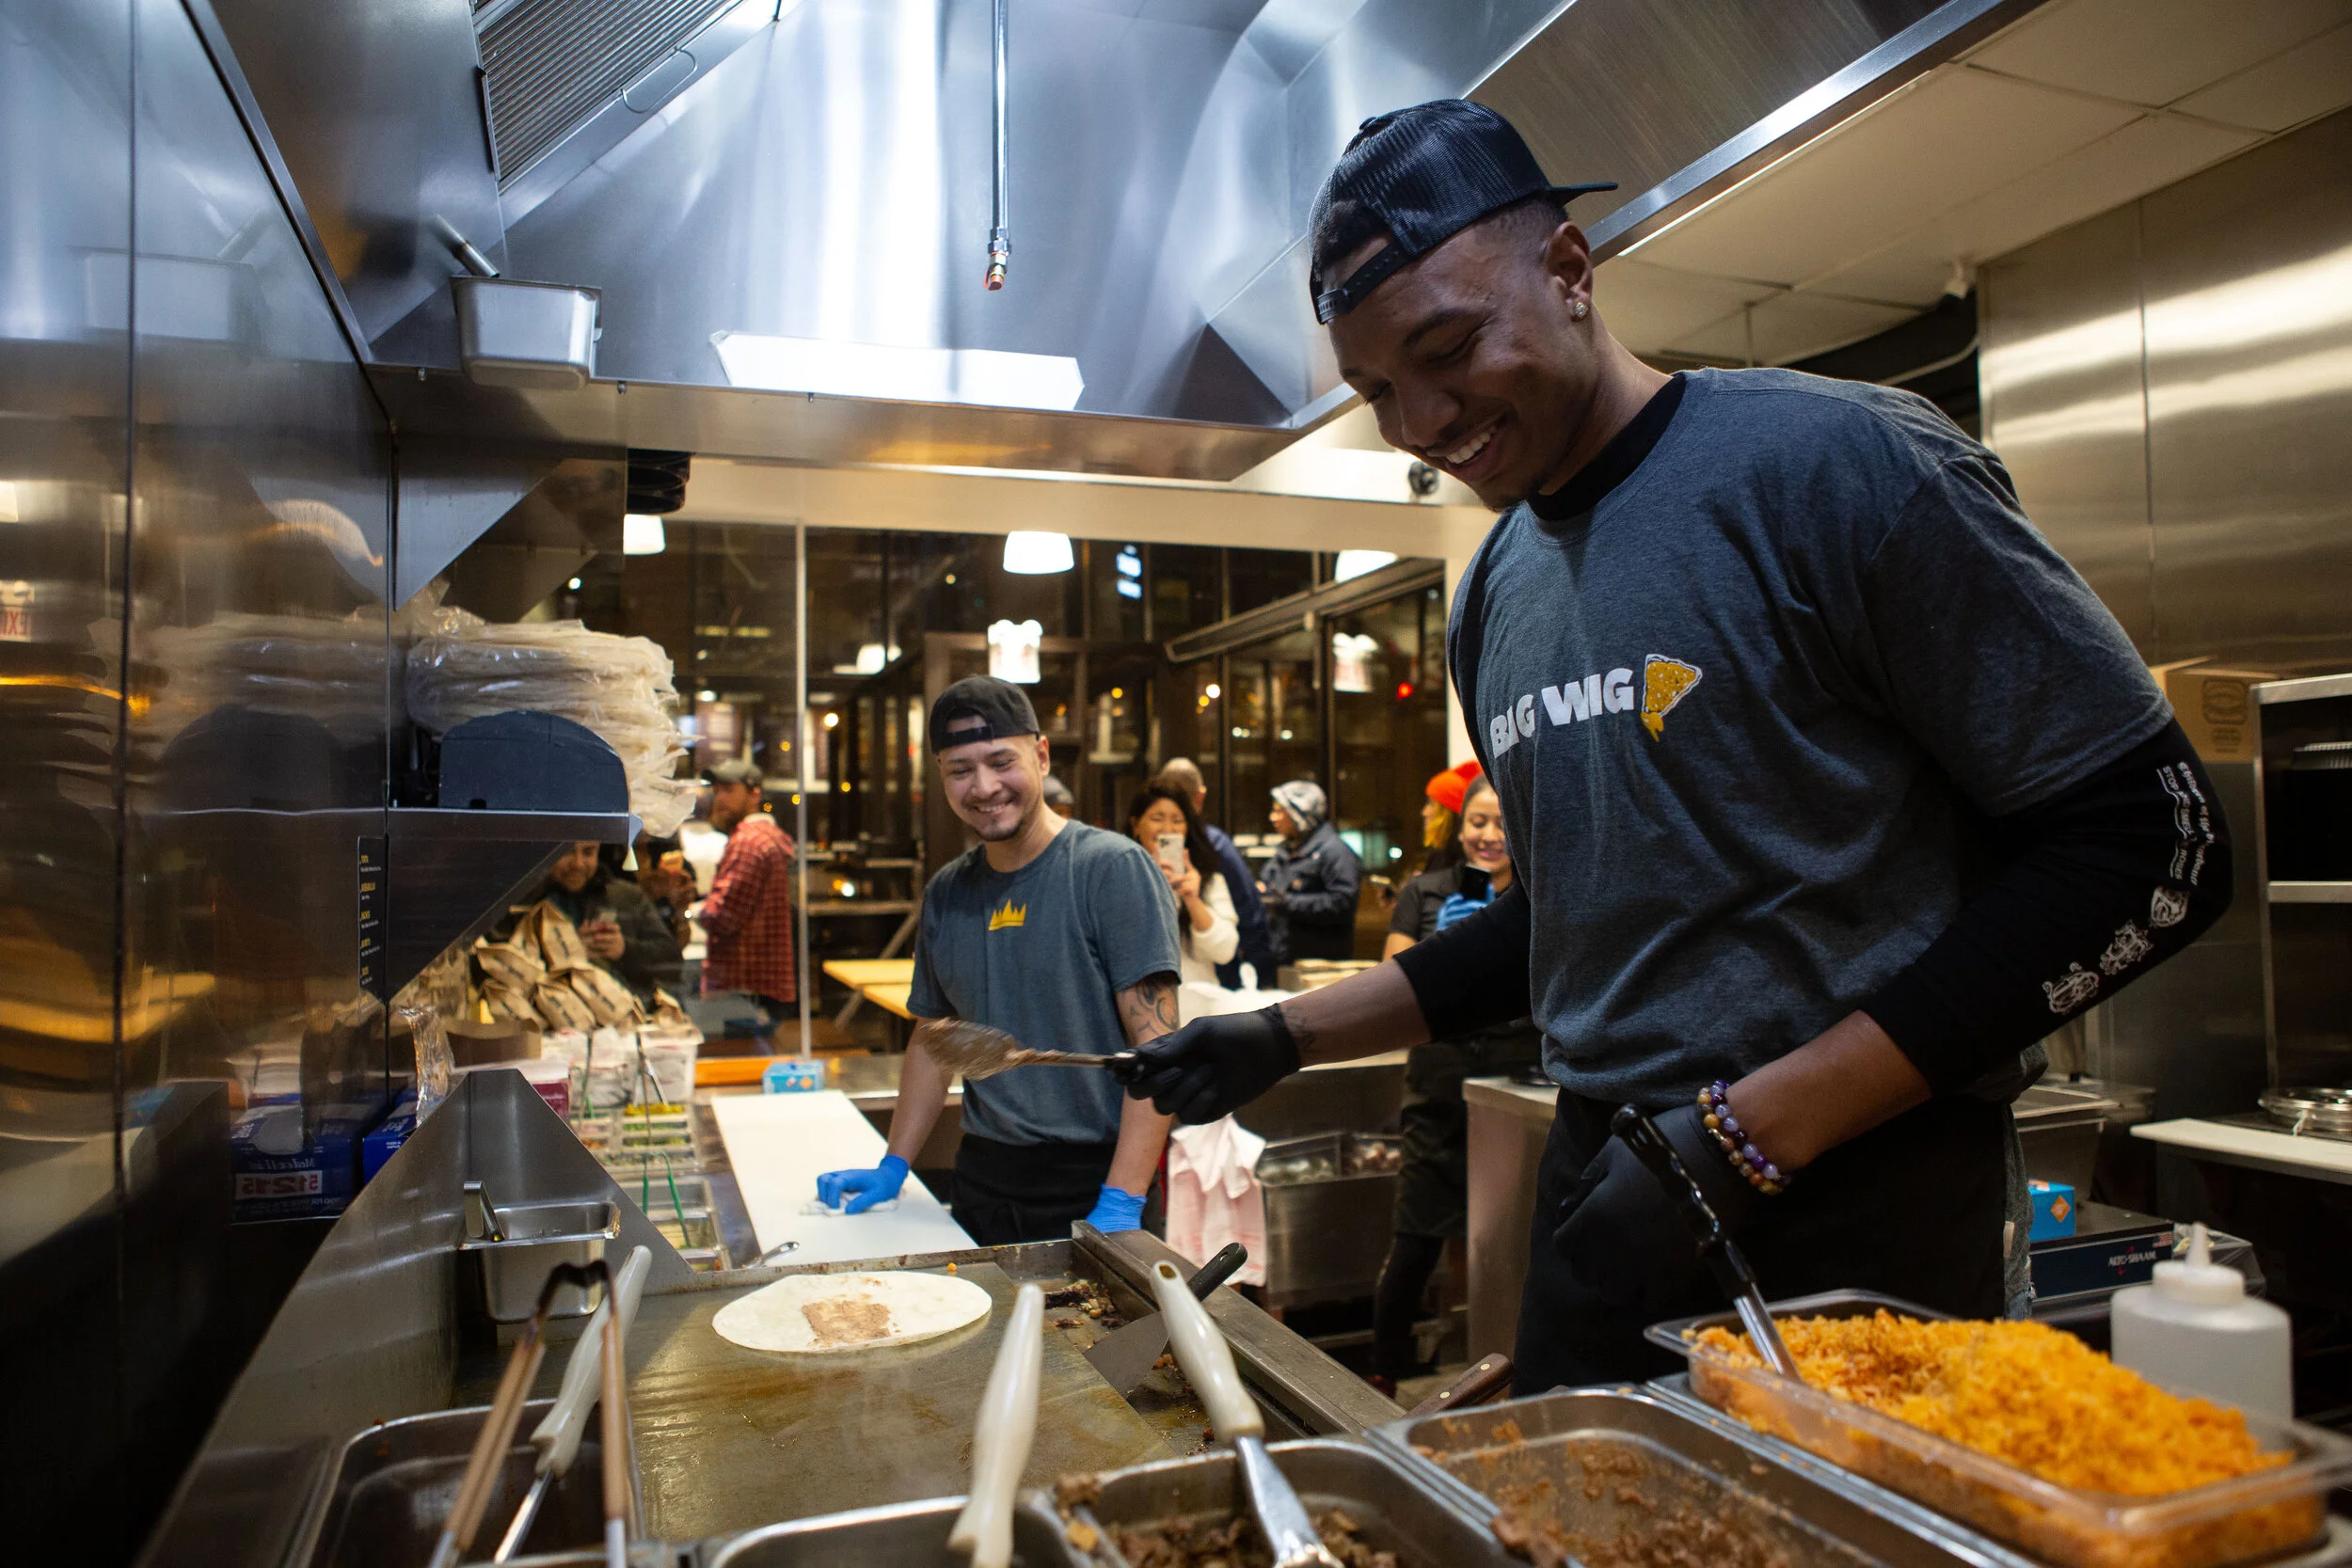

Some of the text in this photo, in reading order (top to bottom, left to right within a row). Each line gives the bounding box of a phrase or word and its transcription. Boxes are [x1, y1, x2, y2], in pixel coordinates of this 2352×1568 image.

[1490, 668, 1634, 759] BIG WIG
[2163, 766, 2179, 790] STOP
